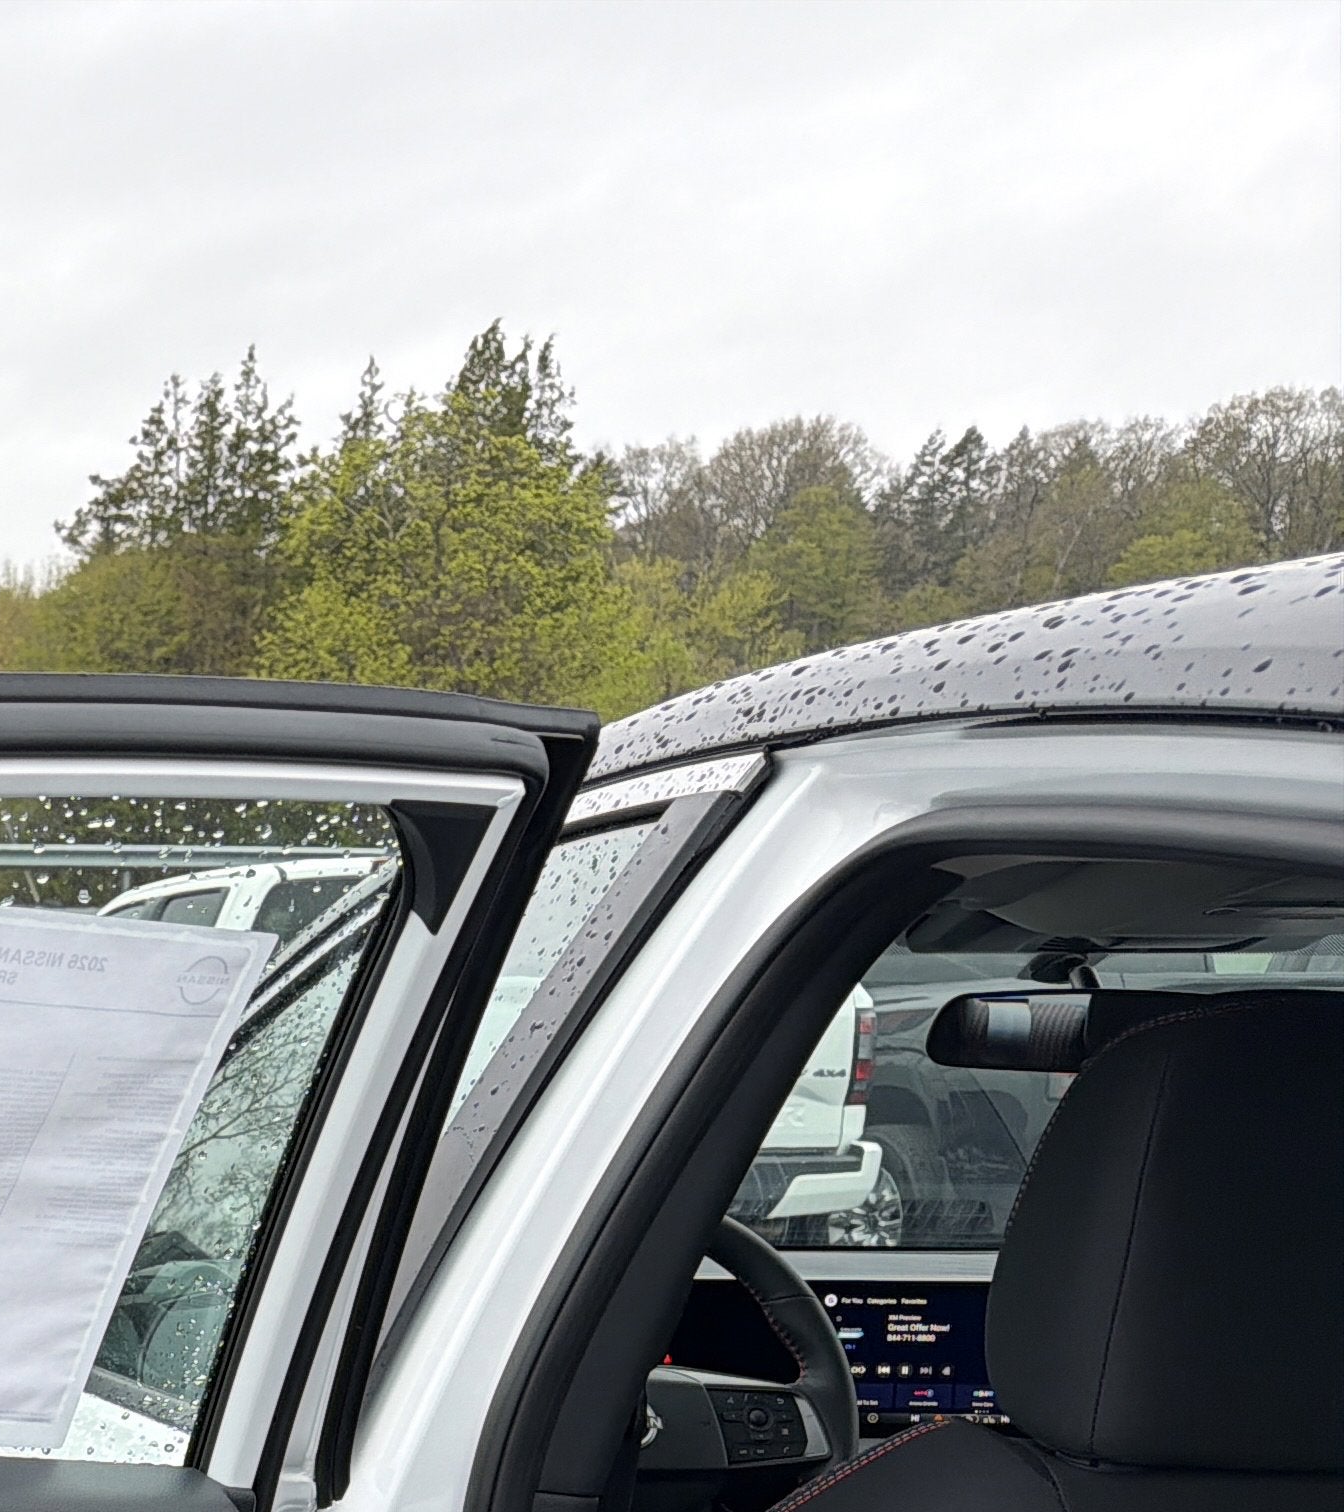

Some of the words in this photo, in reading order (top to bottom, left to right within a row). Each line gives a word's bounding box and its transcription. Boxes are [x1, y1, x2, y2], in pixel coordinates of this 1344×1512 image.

[866, 1297, 897, 1305] Categories
[887, 1324, 909, 1332] Great
[909, 1323, 929, 1332] Offer
[930, 1323, 950, 1332] Now!
